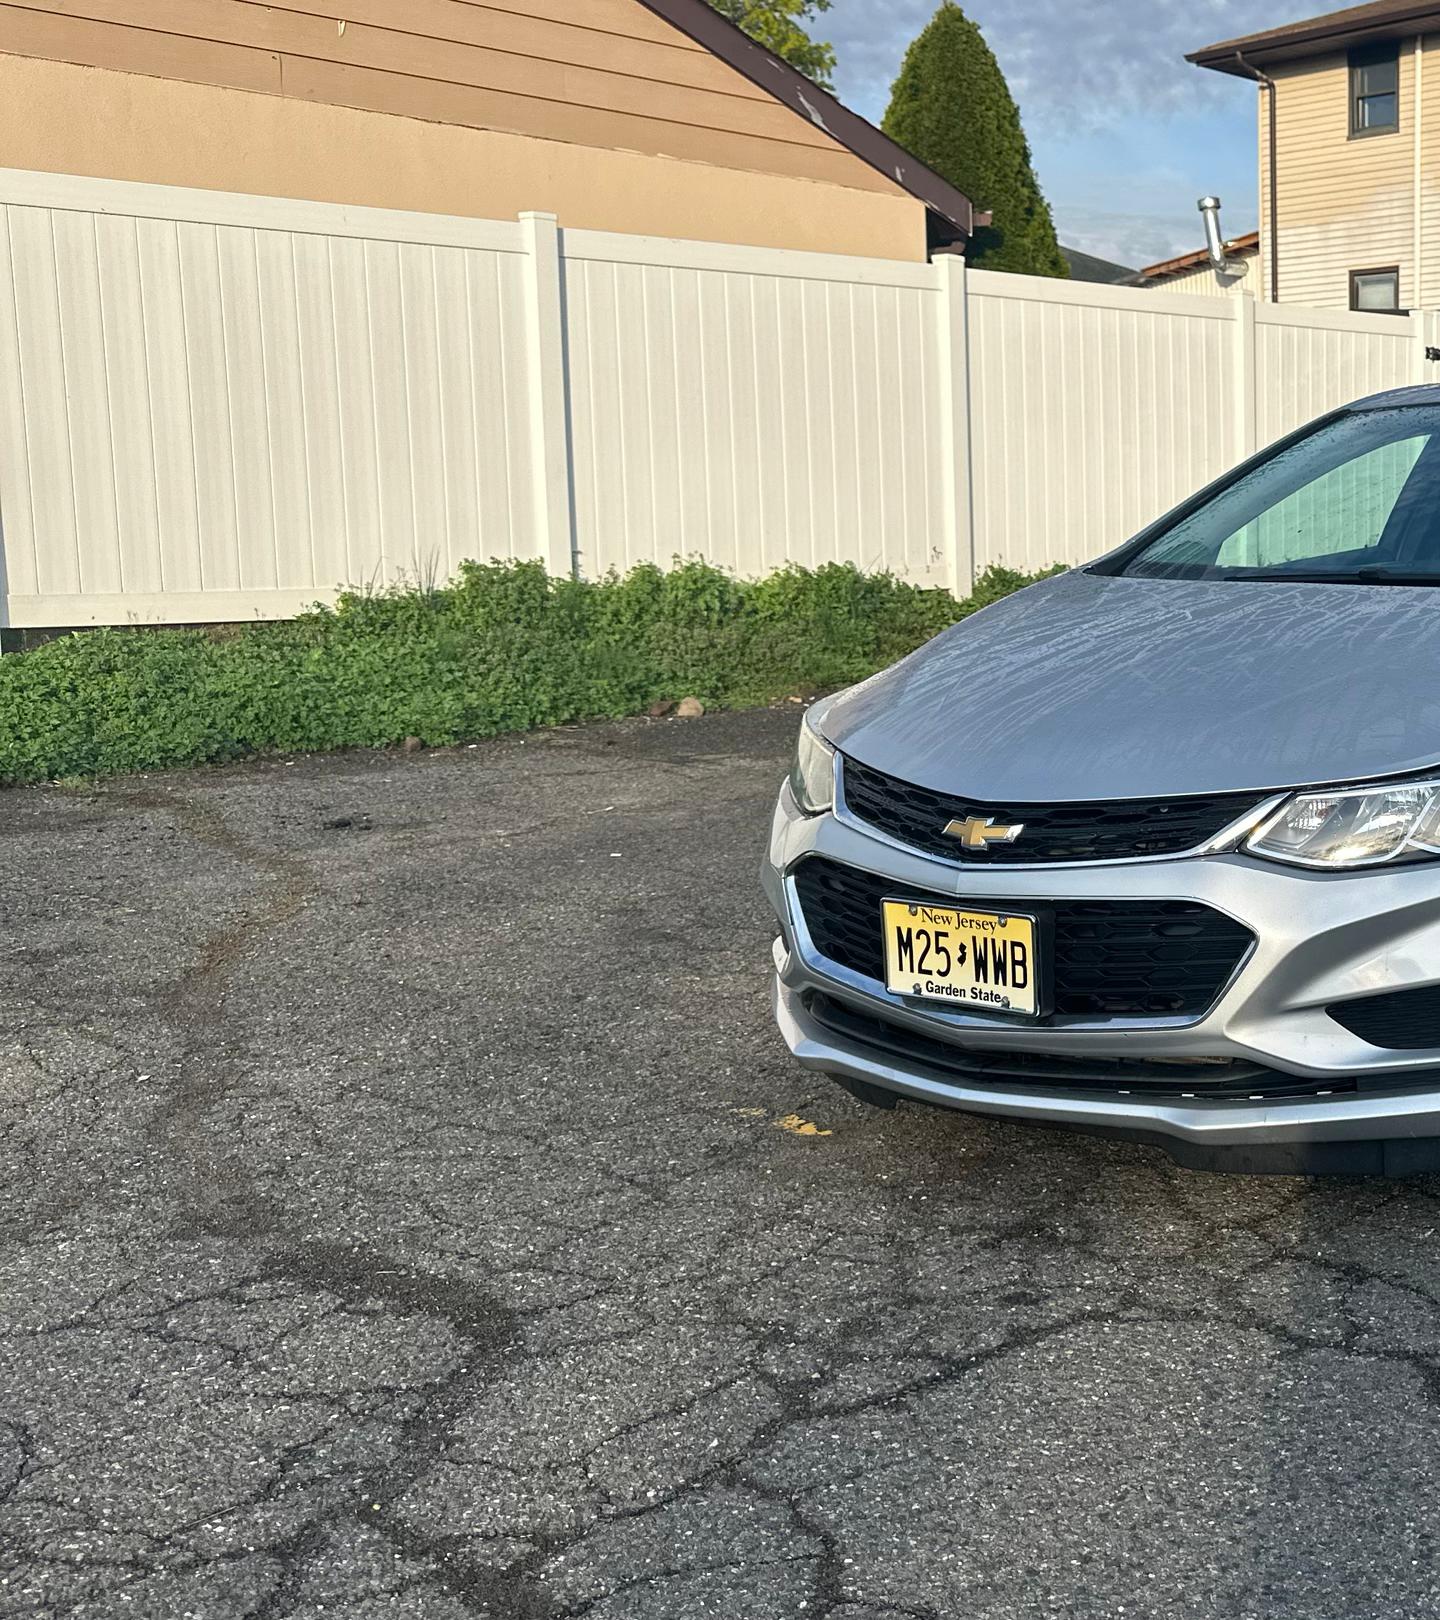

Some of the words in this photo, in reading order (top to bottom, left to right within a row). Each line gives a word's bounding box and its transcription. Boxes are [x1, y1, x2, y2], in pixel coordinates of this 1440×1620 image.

[921, 907, 953, 925] New
[954, 912, 998, 935] Jersey
[896, 926, 951, 978] M25
[972, 935, 1028, 989] WWB
[925, 980, 967, 998] Garden
[970, 986, 1001, 1003] State
